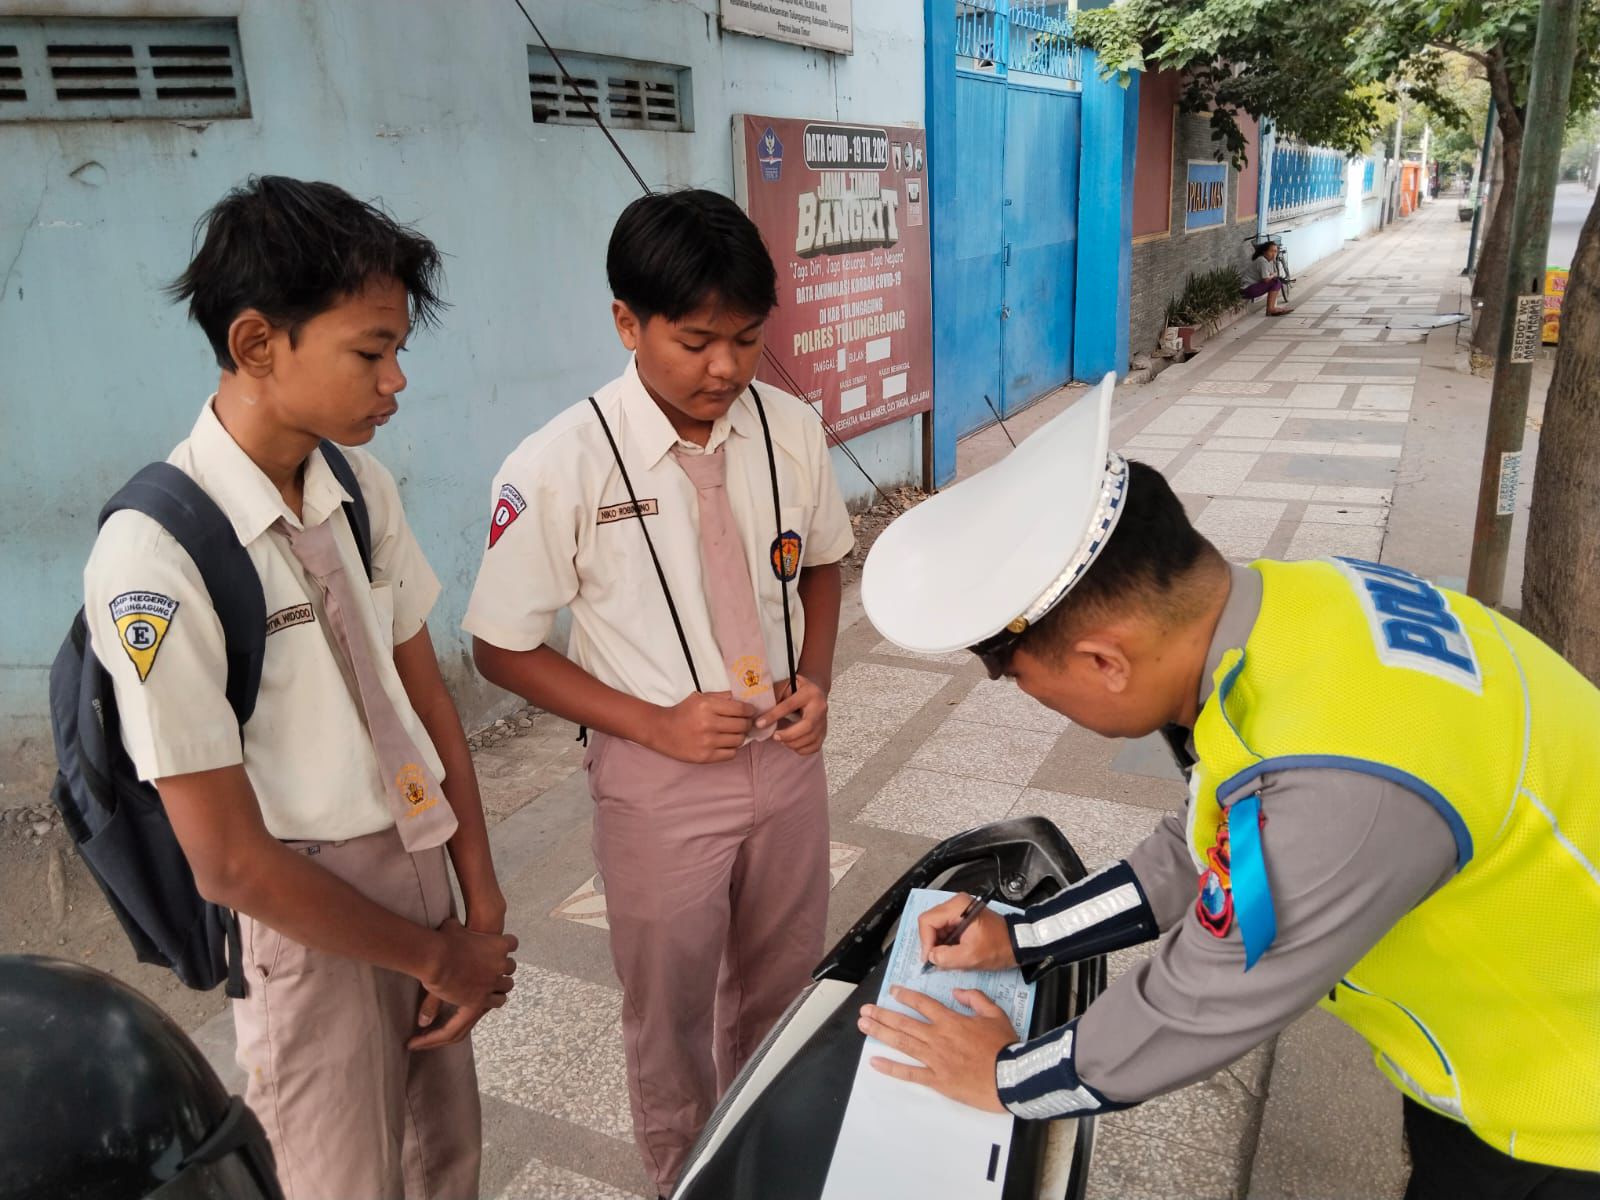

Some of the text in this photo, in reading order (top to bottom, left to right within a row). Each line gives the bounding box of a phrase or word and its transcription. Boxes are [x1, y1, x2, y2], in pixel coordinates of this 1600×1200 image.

[805, 133, 826, 162] DATA
[826, 134, 848, 162] COVID
[853, 136, 861, 162] 19
[873, 137, 888, 163] 2021
[817, 172, 881, 200] JAWA TIMUR
[796, 188, 898, 253] BANGKIT
[827, 258, 840, 277] Jaga
[870, 252, 883, 270] Jaga
[796, 286, 813, 304] DATA
[814, 280, 850, 301] AKUMULASI
[827, 305, 840, 322] KAB
[1515, 299, 1529, 351] SEDOT WC
[793, 310, 905, 356] POLRES TULUNGAGUNG
[601, 509, 617, 519] NIKO
[129, 595, 167, 606] NEGERI
[282, 608, 311, 624] WIDODO
[132, 626, 150, 645] E
